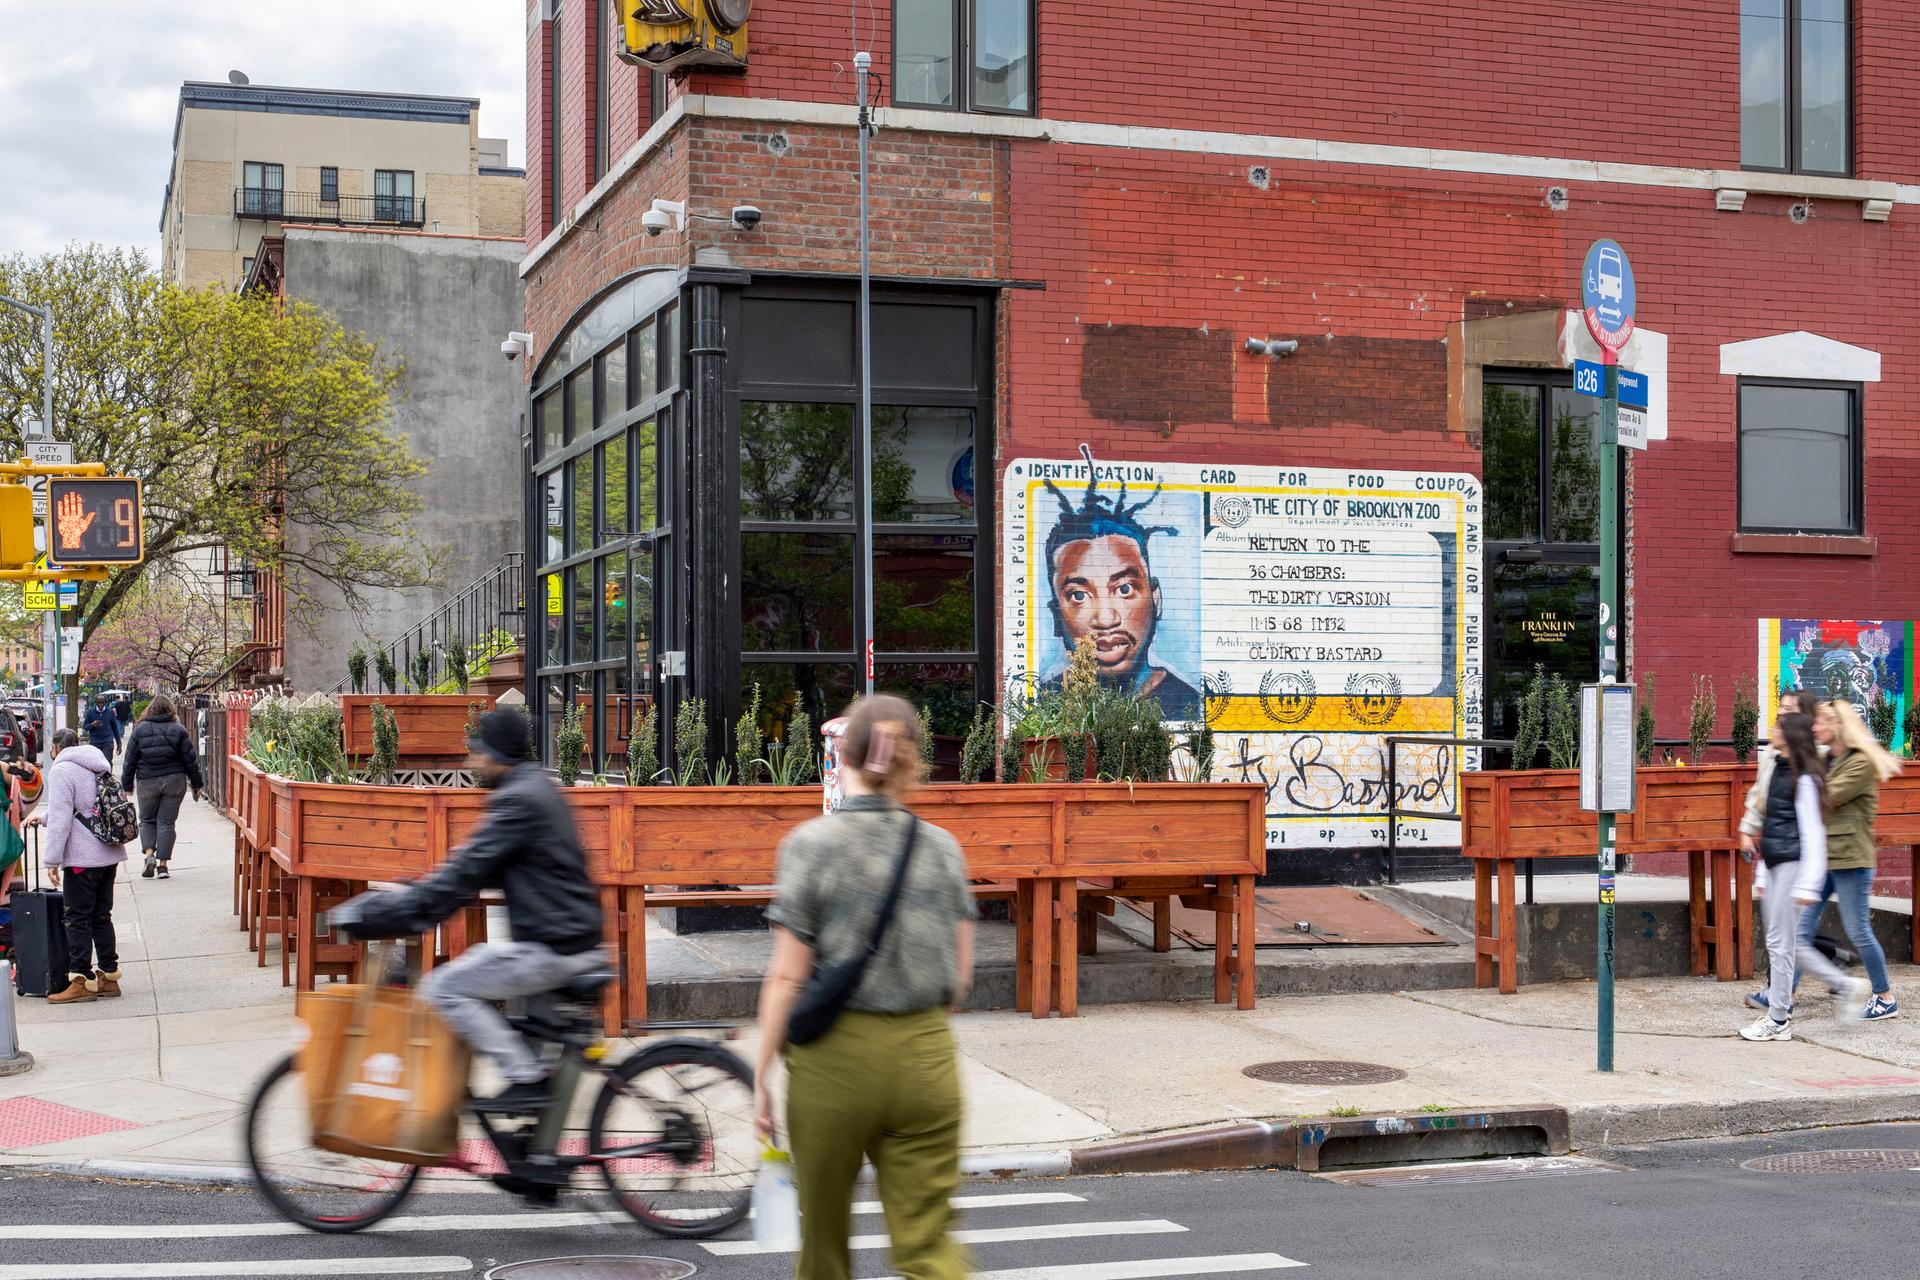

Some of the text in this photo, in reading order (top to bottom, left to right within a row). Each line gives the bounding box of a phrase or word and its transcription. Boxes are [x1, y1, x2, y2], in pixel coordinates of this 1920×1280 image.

[1590, 312, 1631, 345] NO STANDING
[1577, 368, 1598, 393] B26
[38, 445, 58, 453] CITY
[34, 454, 62, 462] SPEED
[1028, 463, 1154, 481] IDENTIFCATION
[1200, 469, 1236, 484] CARD
[1278, 472, 1307, 486] FOR
[1348, 474, 1384, 489] FOOD
[1252, 497, 1440, 520] THE CITY OF BROOKLYN ZOO
[114, 498, 135, 548] 9
[1216, 531, 1246, 543] Album
[1250, 536, 1308, 552] RETURN
[1317, 539, 1335, 552] TO
[1341, 539, 1370, 553] THE
[1466, 523, 1478, 553] AND
[1249, 564, 1345, 579] 36 CHAMBERS:
[27, 594, 55, 605] SCHO
[1249, 590, 1390, 606] THE DIRTY VERSION
[1540, 612, 1557, 620] THE
[1012, 576, 1025, 682] Asistencia
[1522, 620, 1575, 631] FRANKLIN
[1466, 615, 1478, 675] PUBLIC
[1270, 646, 1313, 660] DIRTY
[1316, 647, 1382, 661] BASTARD
[1319, 829, 1336, 843] de
[1371, 823, 1428, 842] Tarjta
